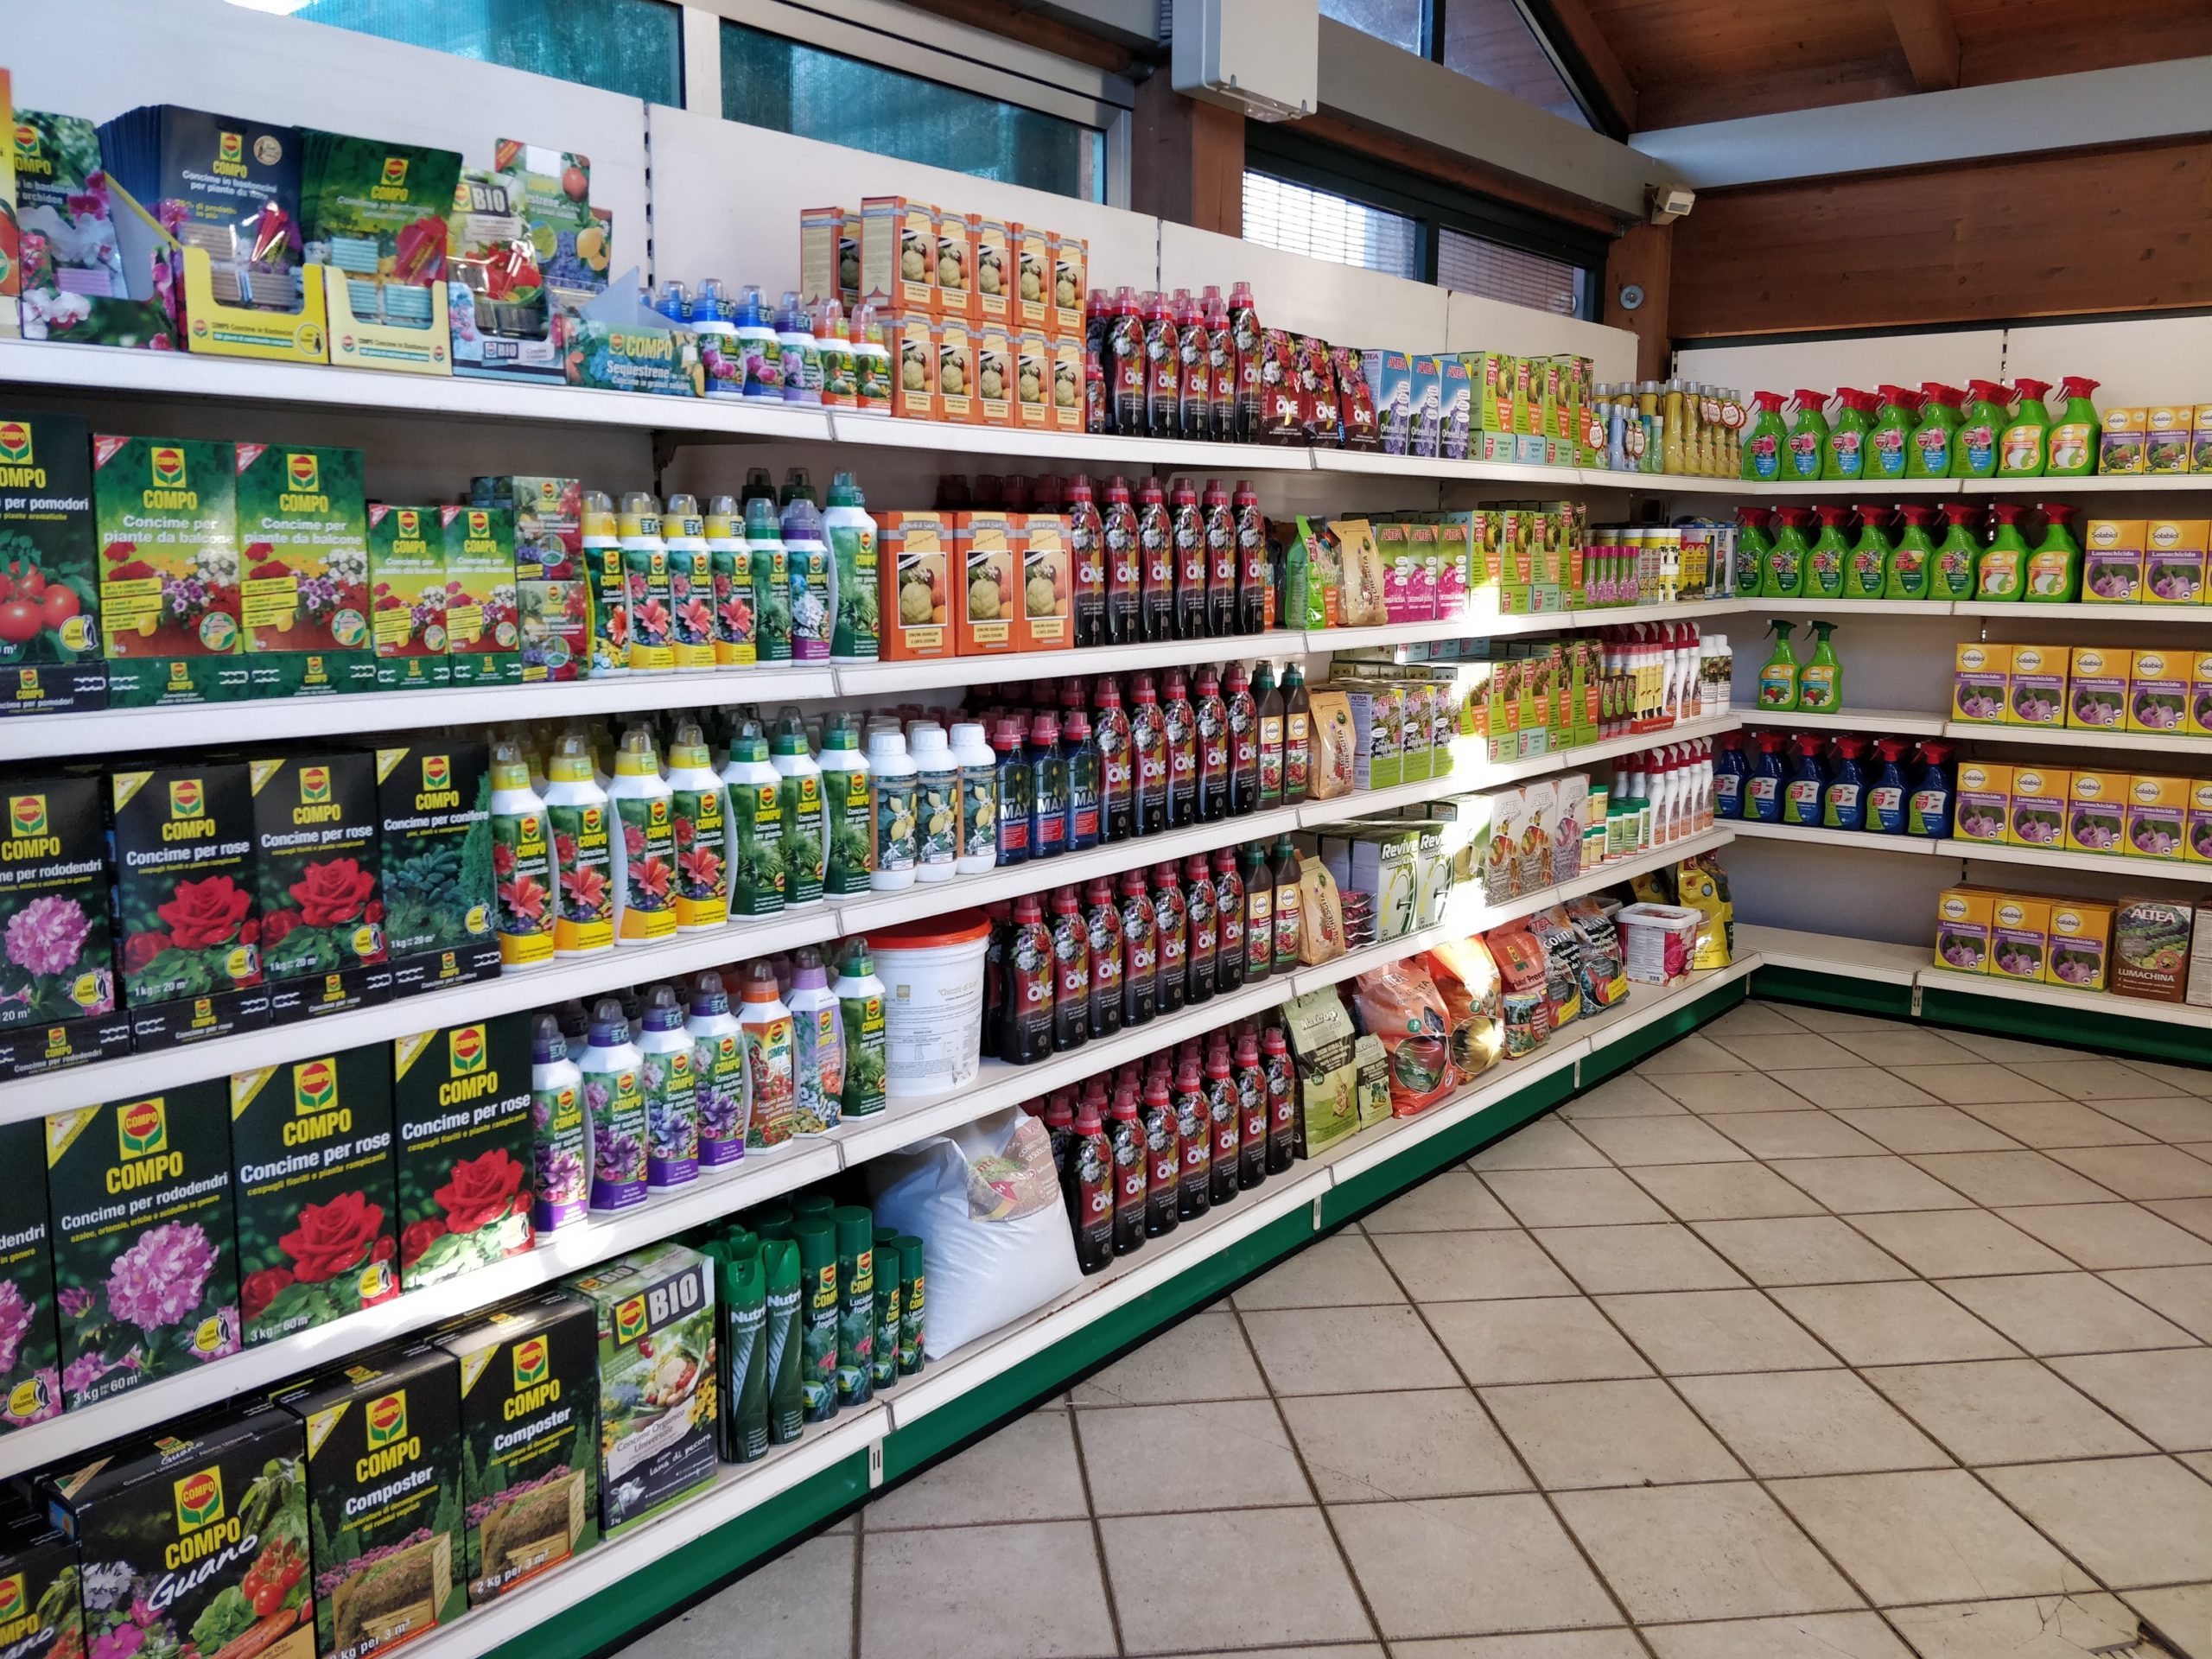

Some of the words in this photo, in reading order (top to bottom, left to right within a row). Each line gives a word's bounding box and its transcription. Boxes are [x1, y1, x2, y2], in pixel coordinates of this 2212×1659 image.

[182, 170, 221, 184] Concime
[213, 160, 248, 179] COMPO
[371, 186, 409, 201] COMPO
[472, 187, 506, 213] BIO
[498, 343, 517, 357] BIO
[626, 336, 672, 360] COMPO
[607, 360, 671, 378] Sequestrene
[1388, 356, 1408, 371] ALTEA
[1417, 360, 1436, 374] ALTEA
[1446, 365, 1466, 379] ALTEA
[1125, 373, 1142, 385] ONE
[1159, 375, 1176, 388] ONE
[1276, 398, 1298, 415] ONE
[1316, 405, 1336, 419] ONE
[1354, 409, 1370, 423] ONE
[0, 468, 46, 488] OMPO
[5, 499, 25, 510] per
[29, 498, 89, 511] pomodori
[143, 490, 197, 510] COMPO
[280, 494, 328, 512] COMPO
[123, 515, 190, 529] Concime
[194, 520, 217, 531] per
[262, 518, 321, 531] Concime
[325, 520, 346, 531] per
[104, 531, 152, 543] piante
[157, 532, 174, 543] da
[245, 533, 287, 544] piante
[293, 535, 308, 544] da
[313, 535, 362, 545] balcone
[1381, 529, 1402, 541] ALTEA
[1412, 529, 1432, 541] ALTEA
[1443, 529, 1462, 541] ALTEA
[393, 541, 426, 553] COMPO
[464, 540, 496, 553] COMPO
[1080, 567, 1103, 583] ONE
[1117, 567, 1139, 582] ONE
[1378, 696, 1396, 707] ALTEA
[1143, 760, 1166, 777] ONE
[1175, 754, 1195, 771] ONE
[1109, 765, 1130, 782] ONE
[416, 791, 459, 810] COMPO
[1038, 796, 1065, 813] MAX
[293, 804, 340, 823] COMPO
[384, 818, 429, 831] Concime
[431, 815, 448, 828] per
[450, 810, 489, 823] conifere
[1001, 803, 1028, 820] MAX
[162, 819, 215, 842] COMPO
[261, 831, 319, 848] Concime
[321, 829, 343, 842] per
[346, 825, 372, 839] rose
[2, 837, 60, 861] COMPO
[126, 849, 190, 866] Concime
[194, 845, 218, 860] per
[220, 841, 249, 854] rose
[1382, 840, 1418, 860] Revive
[16, 869, 36, 882] per
[39, 859, 102, 878] rododendri
[1943, 902, 1967, 912] Solabiol
[1998, 910, 2022, 920] Solabiol
[2130, 908, 2177, 924] ALTEA
[2056, 918, 2081, 928] Solabiol
[1543, 931, 1570, 950] corn
[1098, 958, 1122, 978] ONE
[2118, 969, 2174, 982] LUMACHINA
[1065, 969, 1089, 989] ONE
[1027, 981, 1052, 1001] ONE
[440, 1071, 498, 1106] COMPO
[403, 1114, 470, 1141] Concime
[474, 1106, 495, 1124] per
[501, 1093, 531, 1112] rose
[283, 1108, 351, 1147] COMPO
[240, 1153, 320, 1184] Concime
[324, 1145, 350, 1166] per
[355, 1134, 391, 1153] rose
[106, 1151, 183, 1194] COMPO
[61, 1204, 124, 1230] Concime
[130, 1198, 153, 1215] per
[156, 1172, 228, 1205] rododendri
[604, 1268, 633, 1282] BIO
[649, 1272, 697, 1325] BIO
[73, 1392, 81, 1405] 3
[84, 1388, 99, 1404] kg
[504, 1379, 560, 1421] COMPO
[493, 1407, 571, 1451] Composter
[617, 1431, 651, 1452] Concime
[652, 1408, 684, 1433] Organico
[356, 1437, 420, 1484] COMPO
[182, 1480, 214, 1503] COMPO
[346, 1465, 433, 1515] Composter
[165, 1517, 240, 1569] COMPO
[148, 1535, 257, 1611] Guano
[477, 1581, 484, 1592] 2
[486, 1575, 500, 1589] kg
[505, 1567, 521, 1581] per
[525, 1560, 531, 1568] 3
[360, 1637, 378, 1653] per
[385, 1630, 391, 1640] 3
